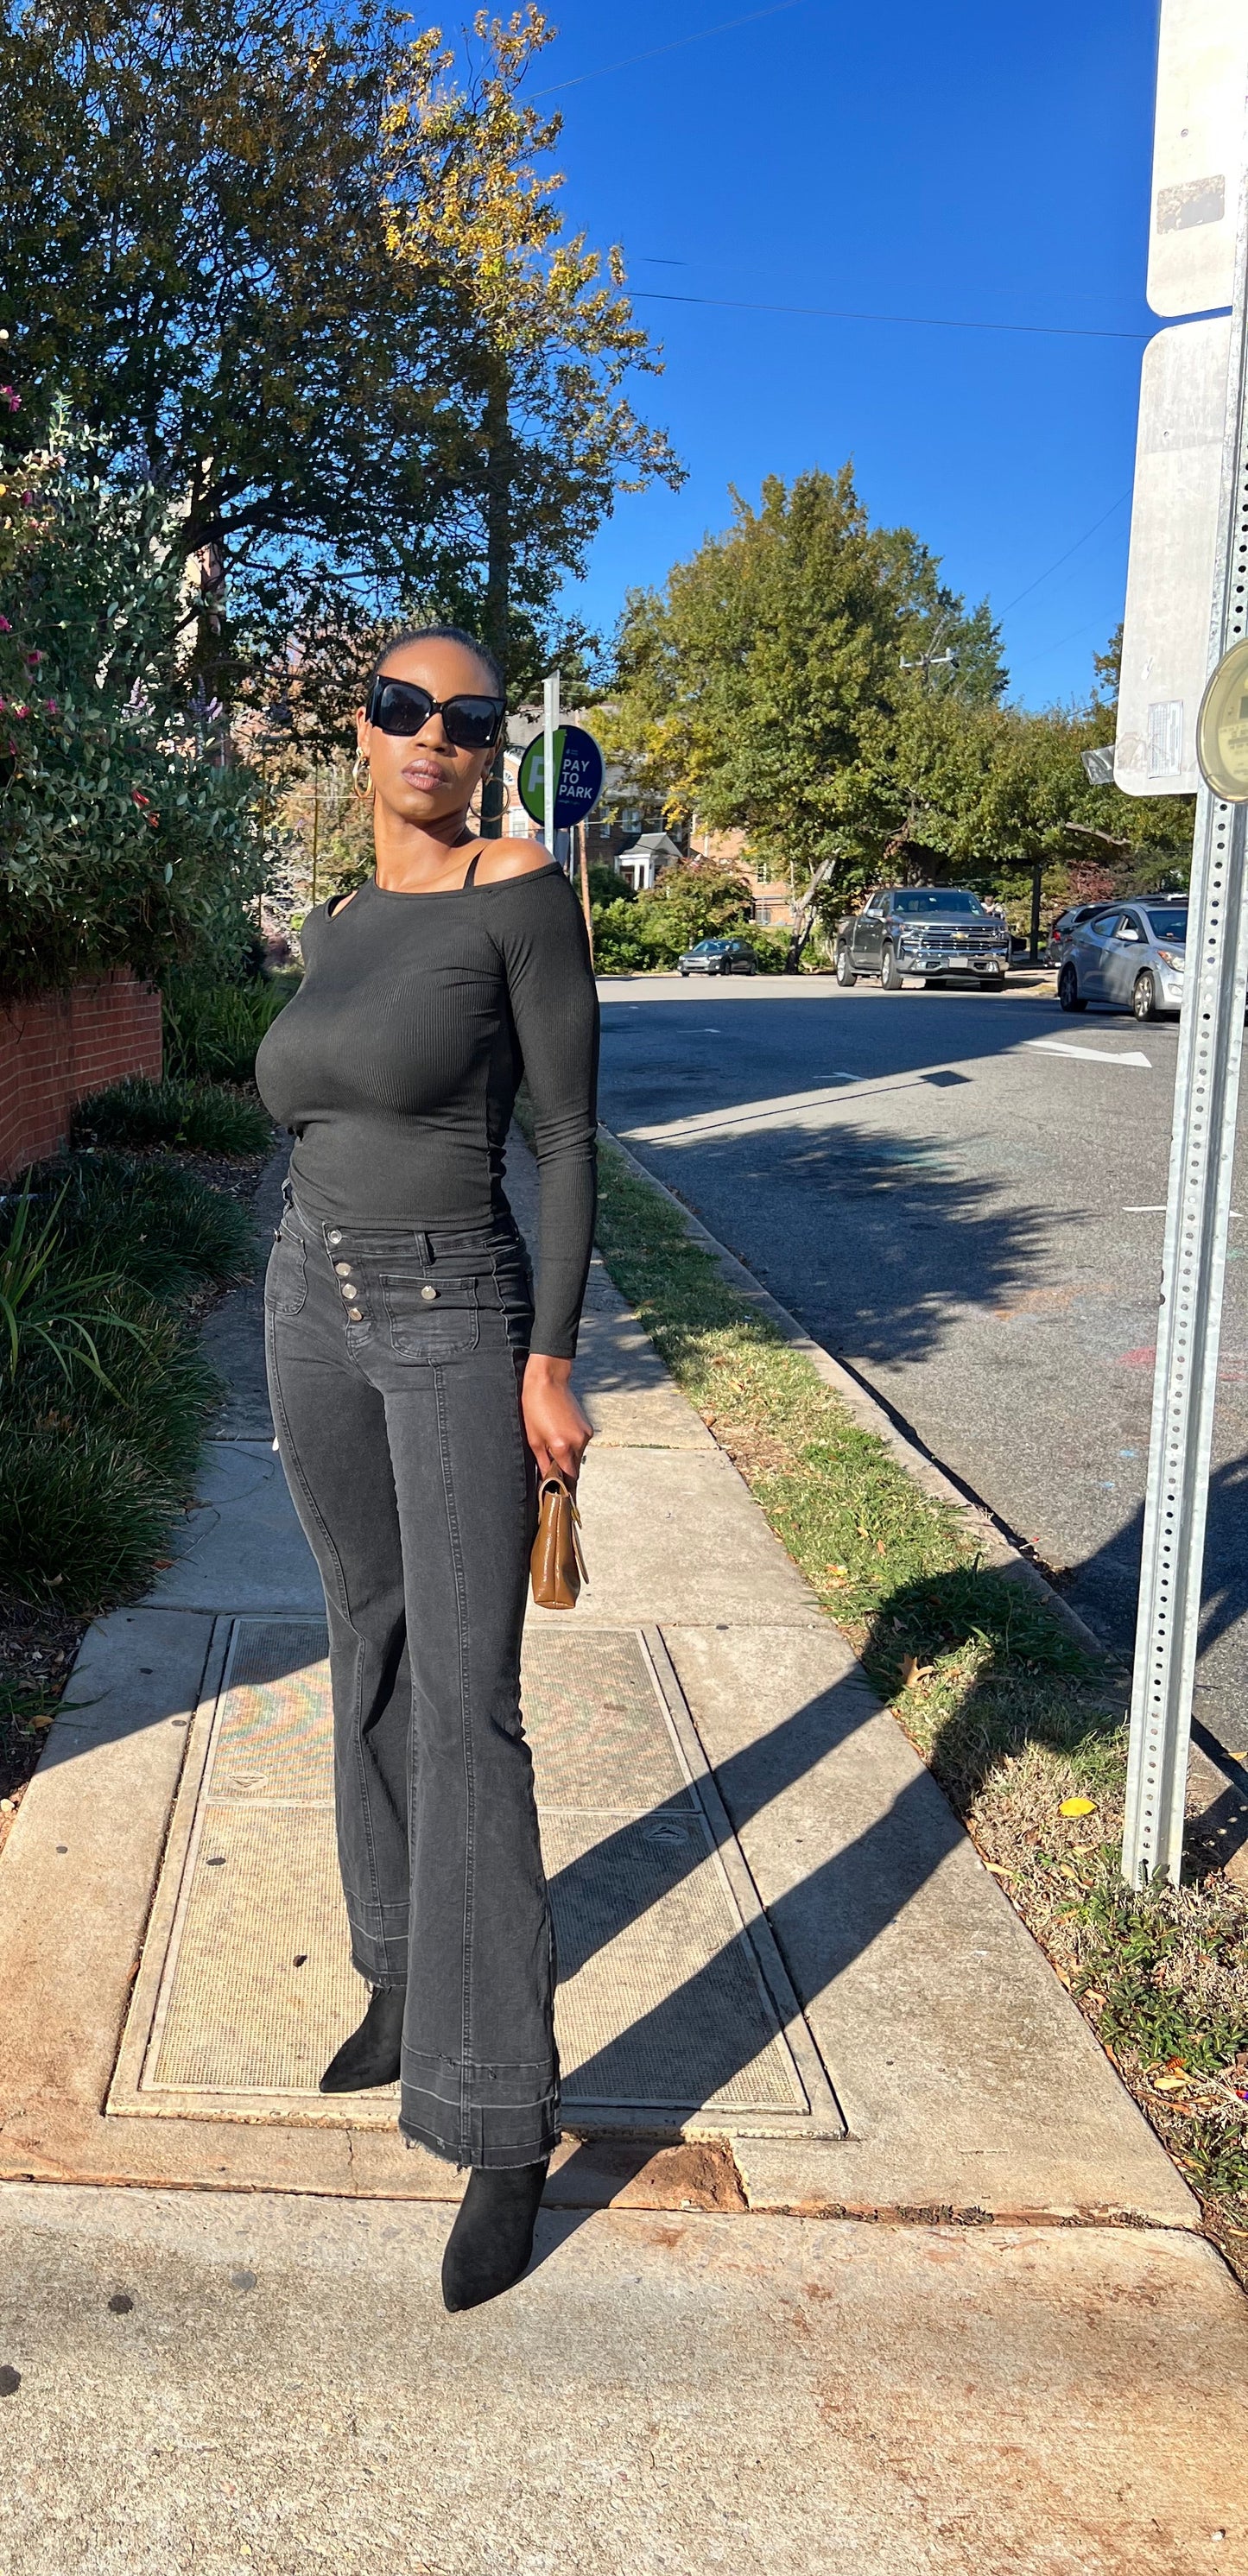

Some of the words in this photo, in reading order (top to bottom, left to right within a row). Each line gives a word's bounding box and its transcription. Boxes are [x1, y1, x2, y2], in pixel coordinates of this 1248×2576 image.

[563, 759, 590, 772] PAY
[562, 771, 579, 783] TO
[559, 784, 592, 799] PARK
